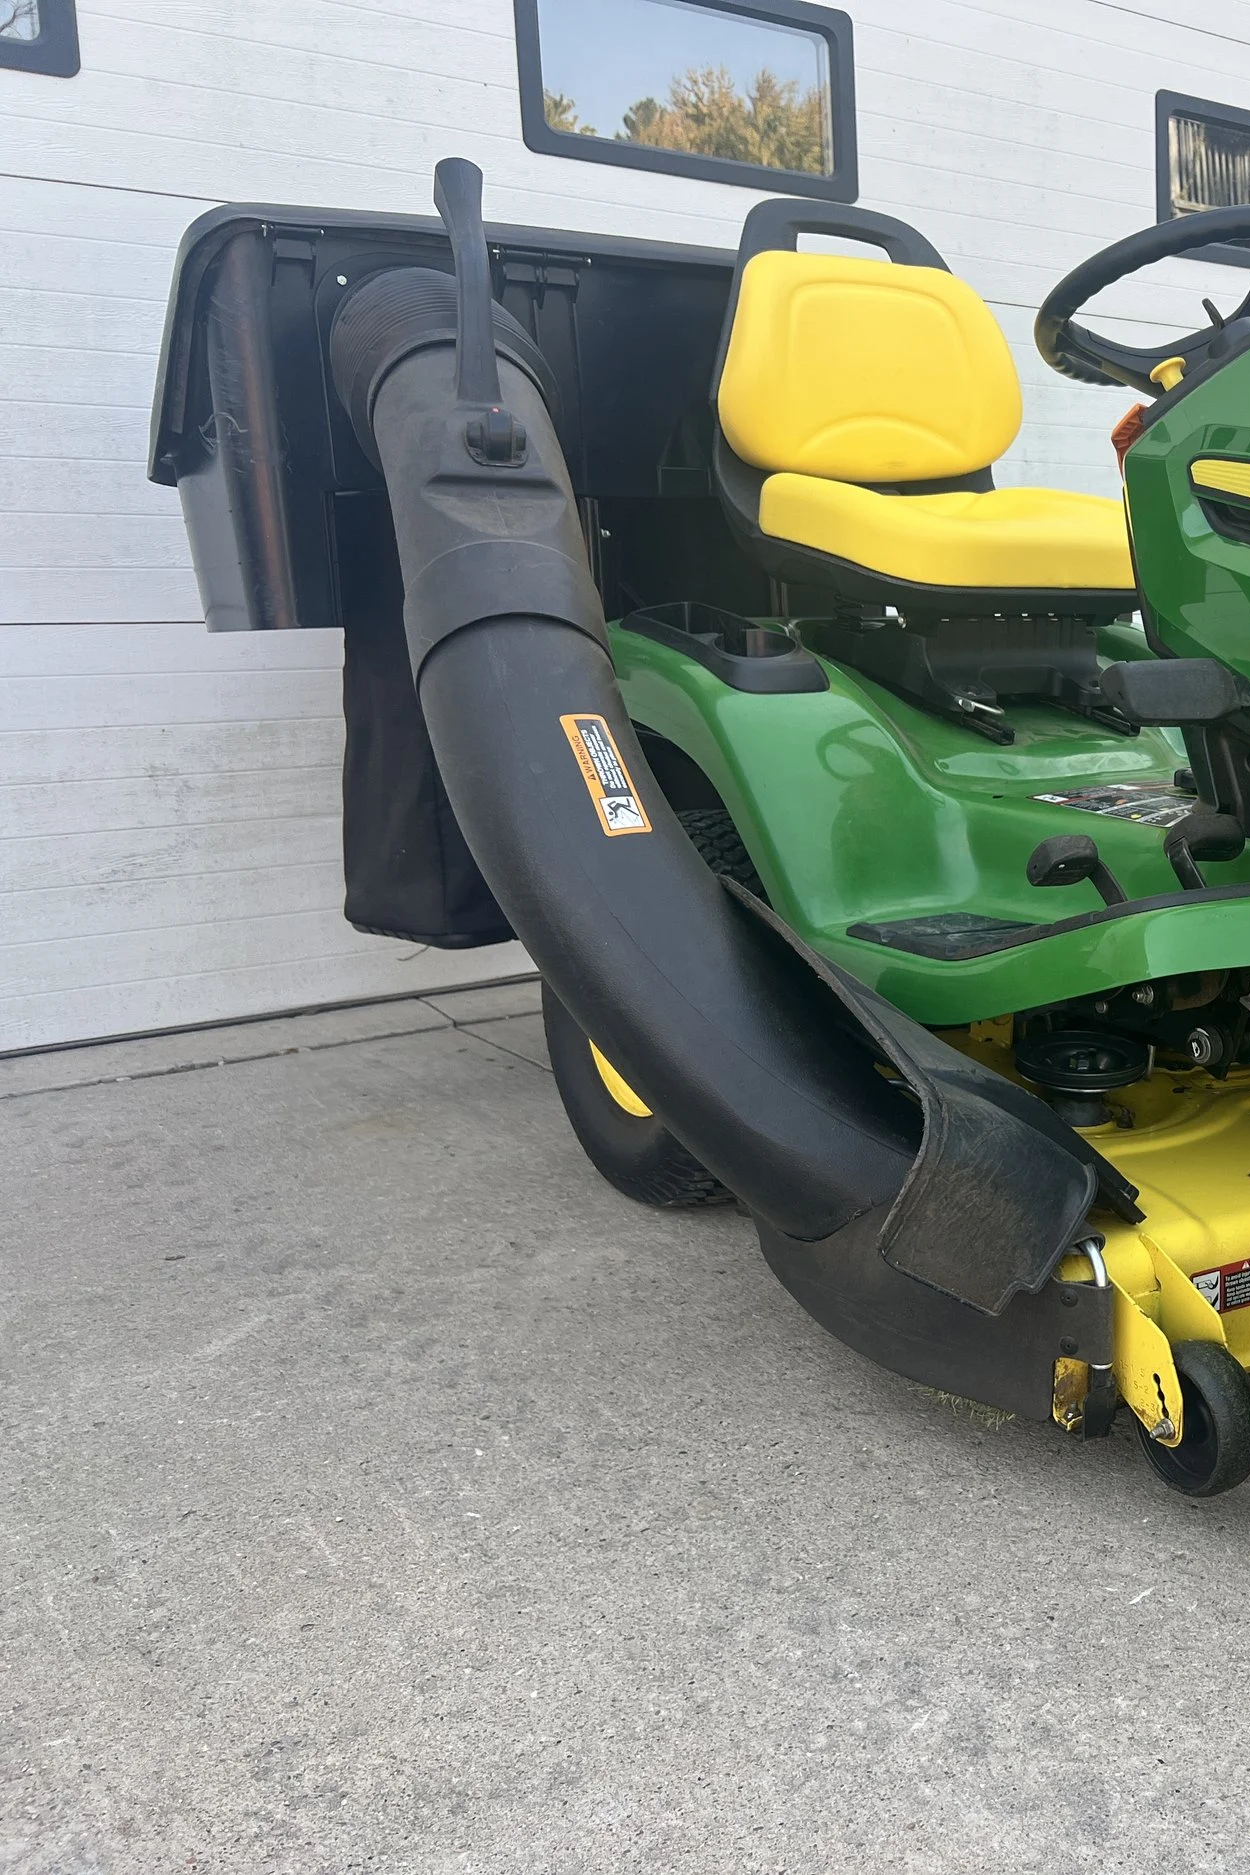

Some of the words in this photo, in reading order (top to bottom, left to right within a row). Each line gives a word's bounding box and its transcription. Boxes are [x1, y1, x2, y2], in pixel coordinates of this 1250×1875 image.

[572, 735, 592, 774] WARNING
[581, 729, 597, 758] OBJECTS
[592, 757, 608, 785] THROWN
